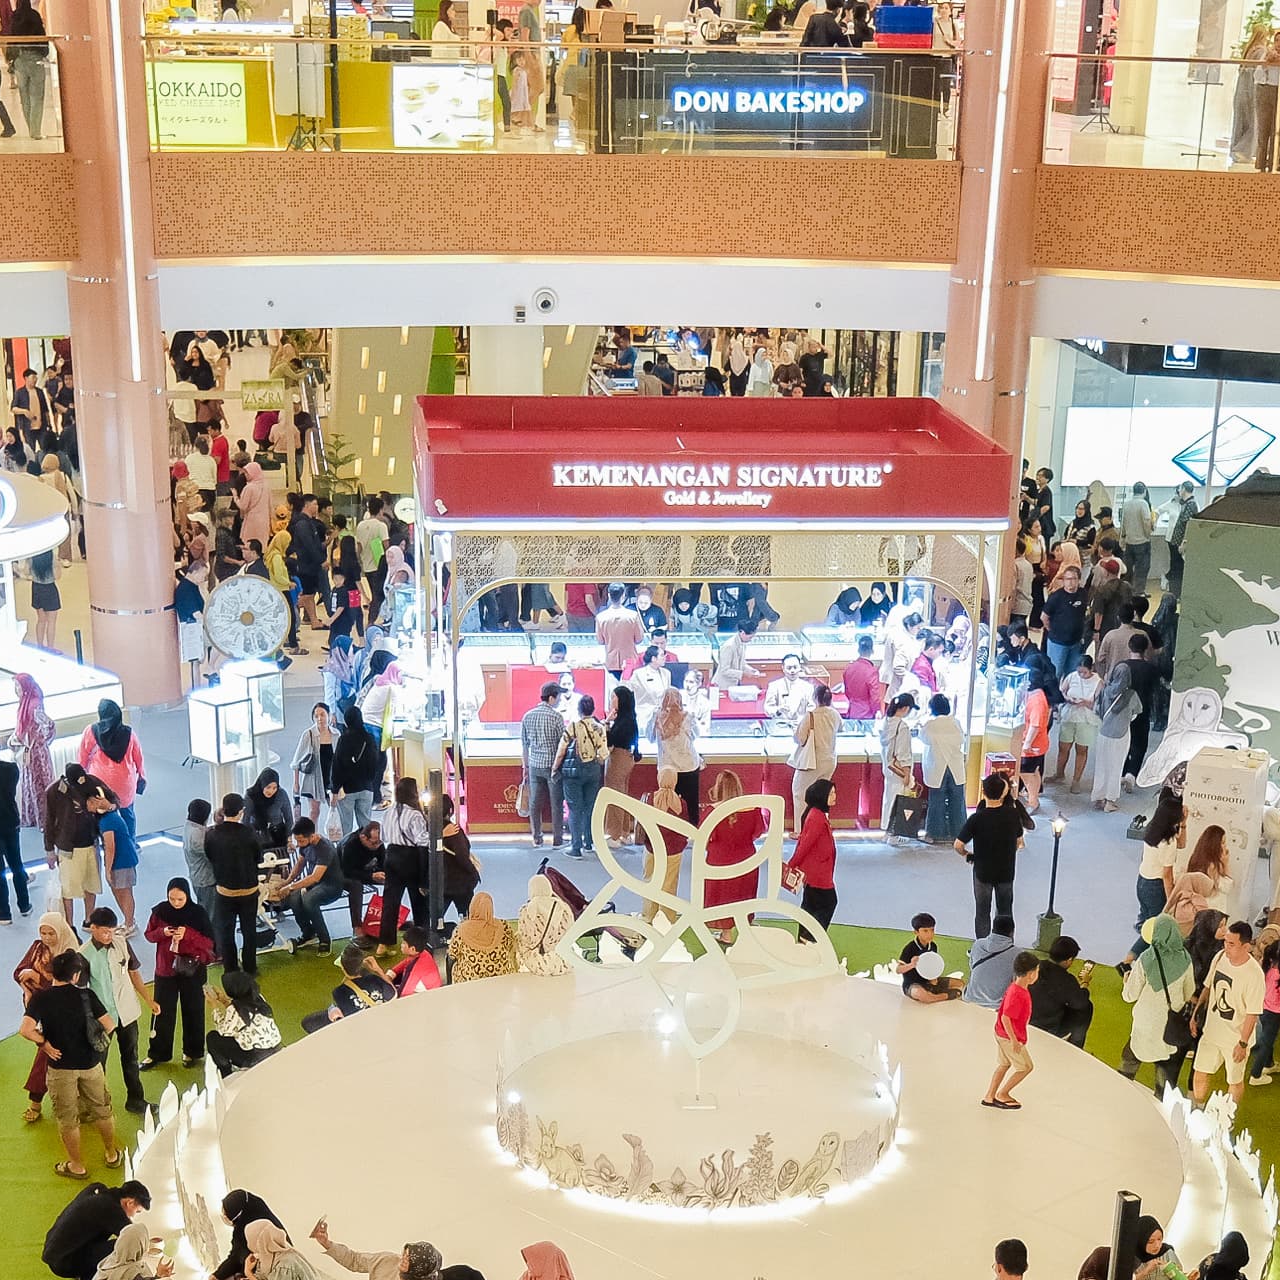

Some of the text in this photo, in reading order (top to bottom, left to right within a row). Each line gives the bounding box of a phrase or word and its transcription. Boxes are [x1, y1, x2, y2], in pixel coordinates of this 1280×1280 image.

[674, 91, 864, 113] DON BAKESHOP
[553, 465, 729, 487] KEMENANGAN
[1190, 791, 1246, 805] PHOTOBOOTH
